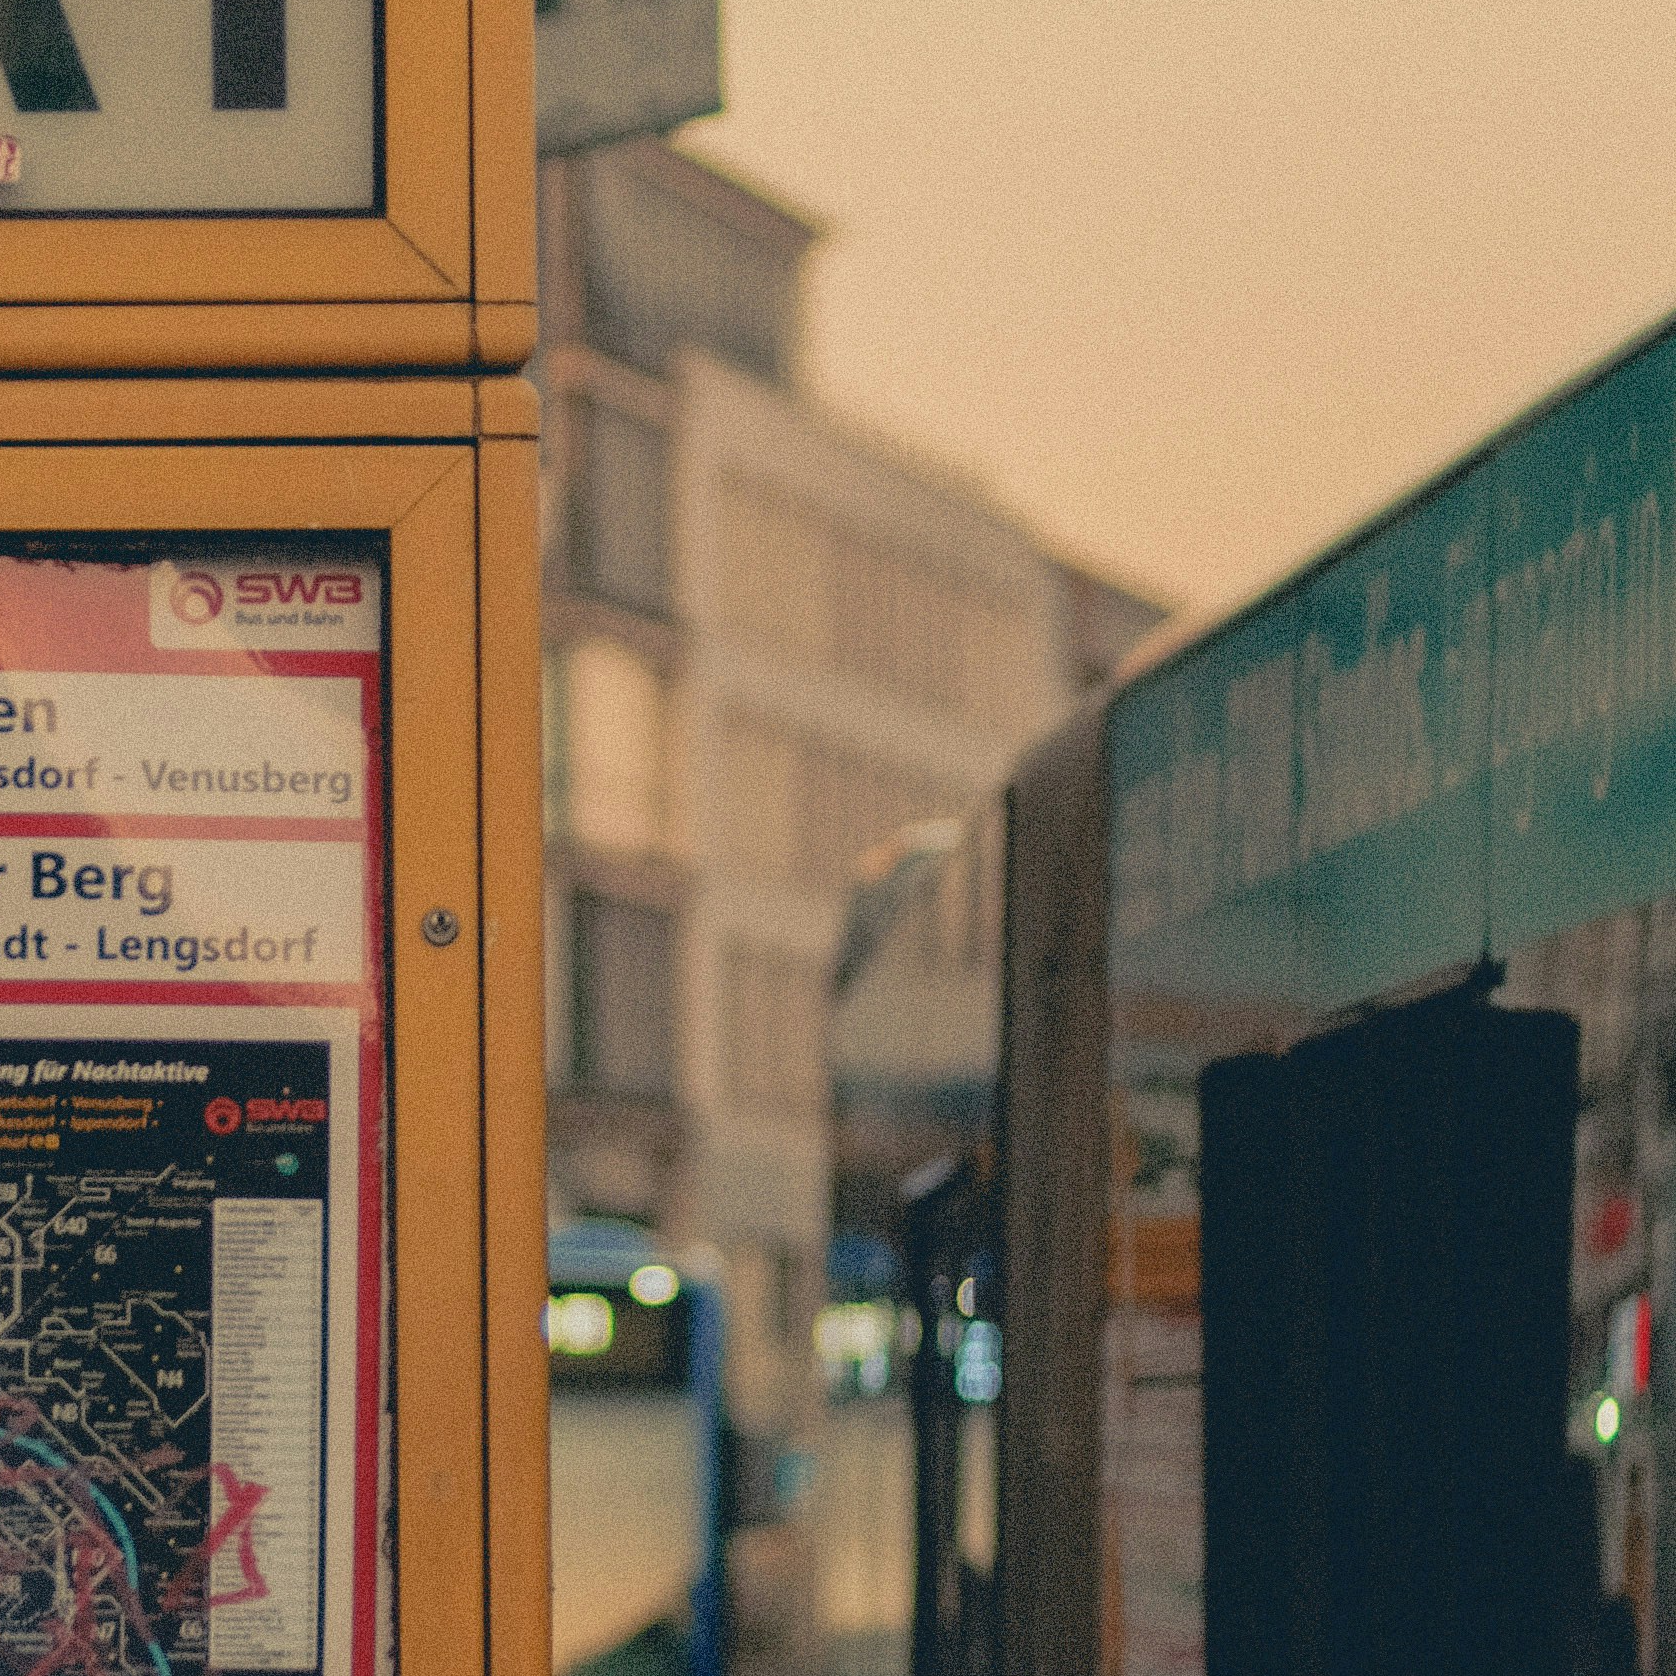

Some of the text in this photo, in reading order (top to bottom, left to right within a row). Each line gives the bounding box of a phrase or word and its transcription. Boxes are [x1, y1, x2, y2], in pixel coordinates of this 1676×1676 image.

[235, 573, 363, 604] SWB
[142, 758, 355, 803] Venusberg
[31, 851, 175, 917] Berg
[96, 926, 320, 971] Lengsdorf
[32, 1059, 68, 1085] für
[72, 1060, 210, 1083] Nachtaktive
